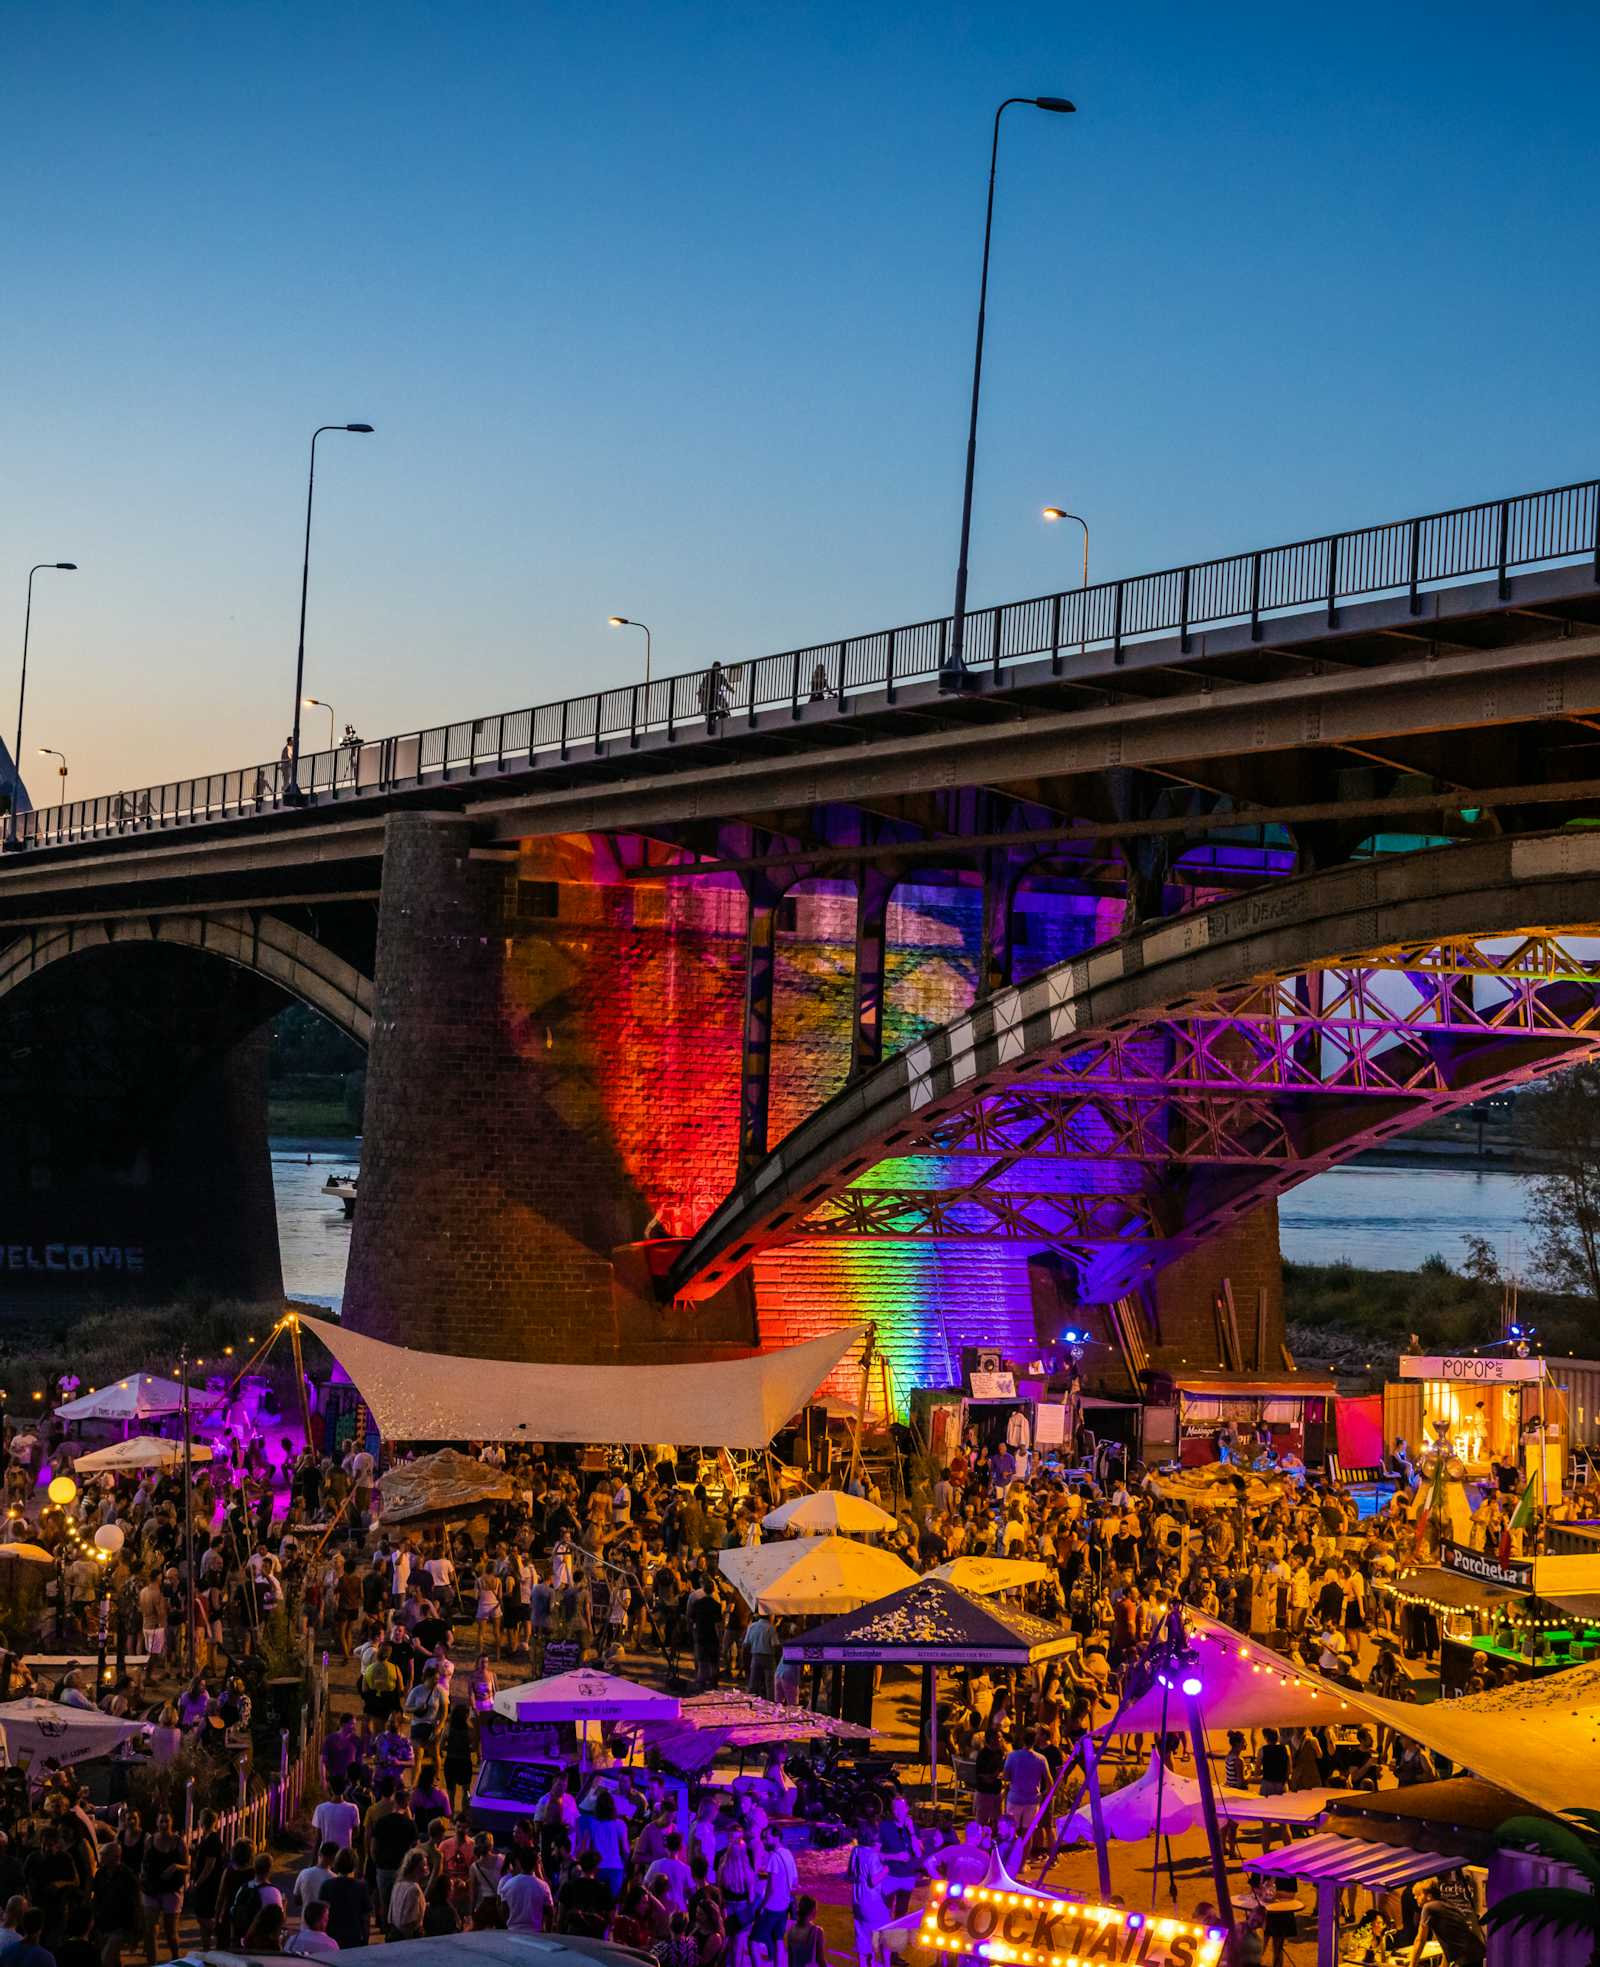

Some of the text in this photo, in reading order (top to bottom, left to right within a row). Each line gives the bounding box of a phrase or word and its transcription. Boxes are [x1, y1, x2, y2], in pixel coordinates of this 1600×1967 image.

[0, 1242, 145, 1272] ELCOME
[1442, 1359, 1495, 1379] POPOP
[1495, 1361, 1504, 1378] ART
[1440, 1543, 1447, 1562] I
[936, 1899, 1198, 1967] COCKTAILS
